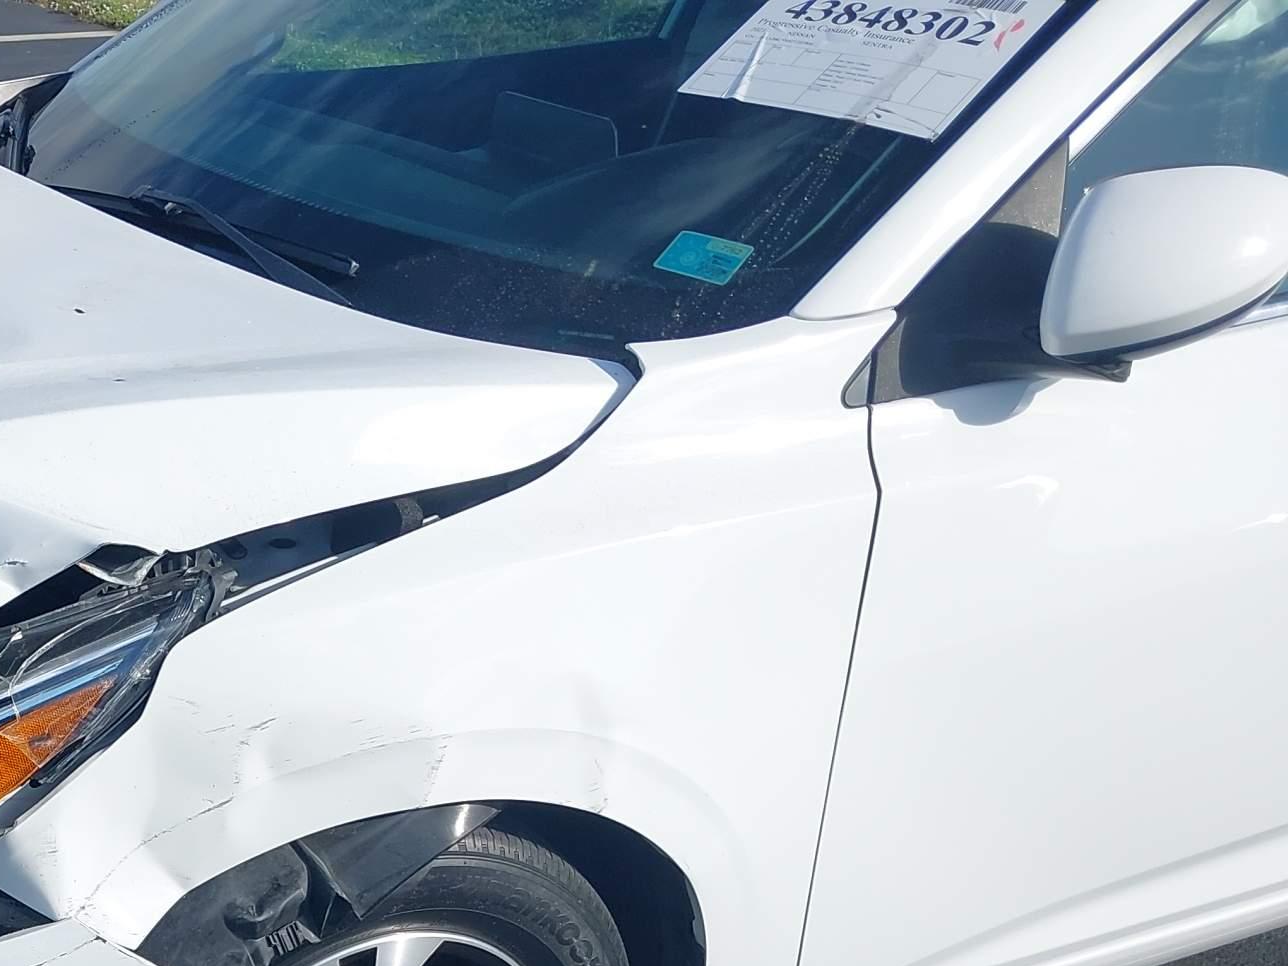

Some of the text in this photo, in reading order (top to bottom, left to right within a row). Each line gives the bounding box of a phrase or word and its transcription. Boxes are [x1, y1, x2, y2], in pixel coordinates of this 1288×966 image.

[758, 18, 816, 31] Progressive
[817, 24, 859, 37] Casualty
[864, 30, 916, 44] Insurance
[785, 0, 996, 47] 43848302
[862, 40, 894, 50] SENTRA
